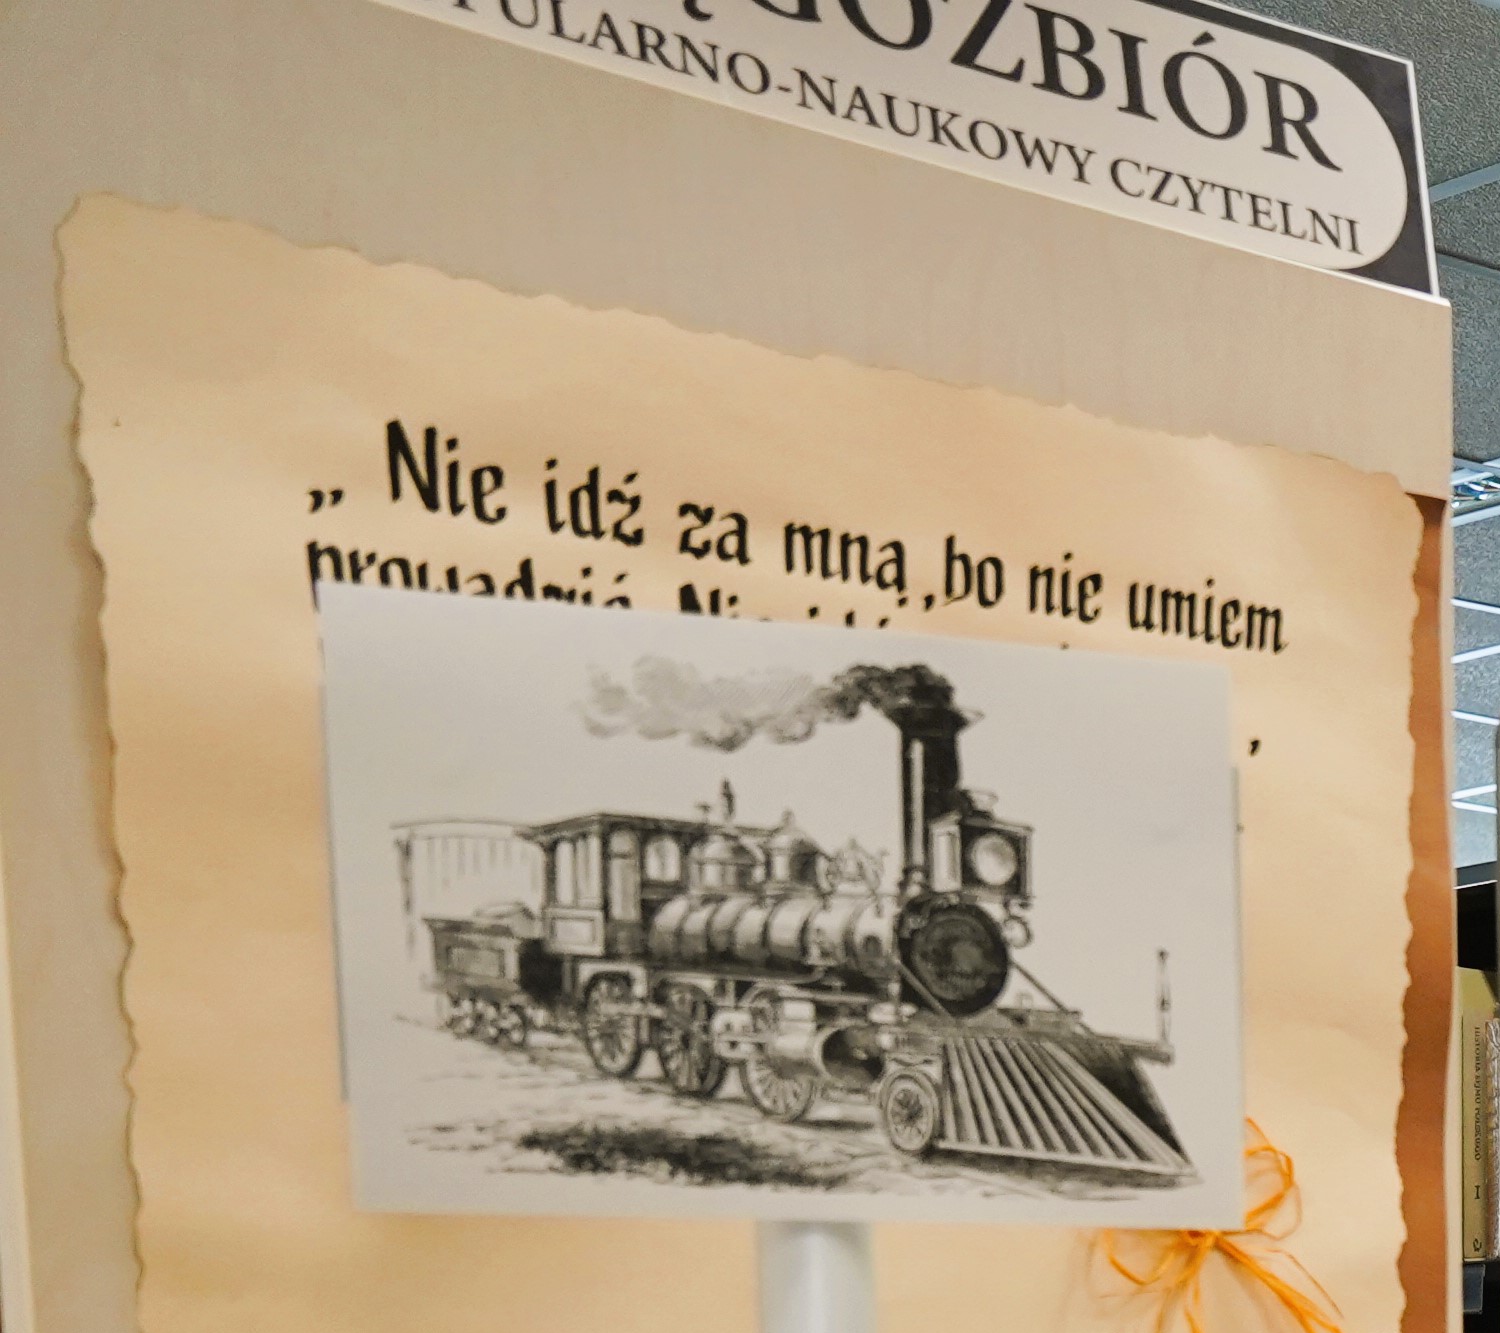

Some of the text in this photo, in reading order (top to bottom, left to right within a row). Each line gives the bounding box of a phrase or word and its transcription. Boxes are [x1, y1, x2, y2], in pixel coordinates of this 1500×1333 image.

[1109, 157, 1366, 256] CZYTELNI
[386, 420, 507, 526] Nie
[544, 457, 644, 548] idź
[678, 499, 751, 567] za
[1027, 553, 1102, 623] nie
[1127, 575, 1289, 653] umiem
